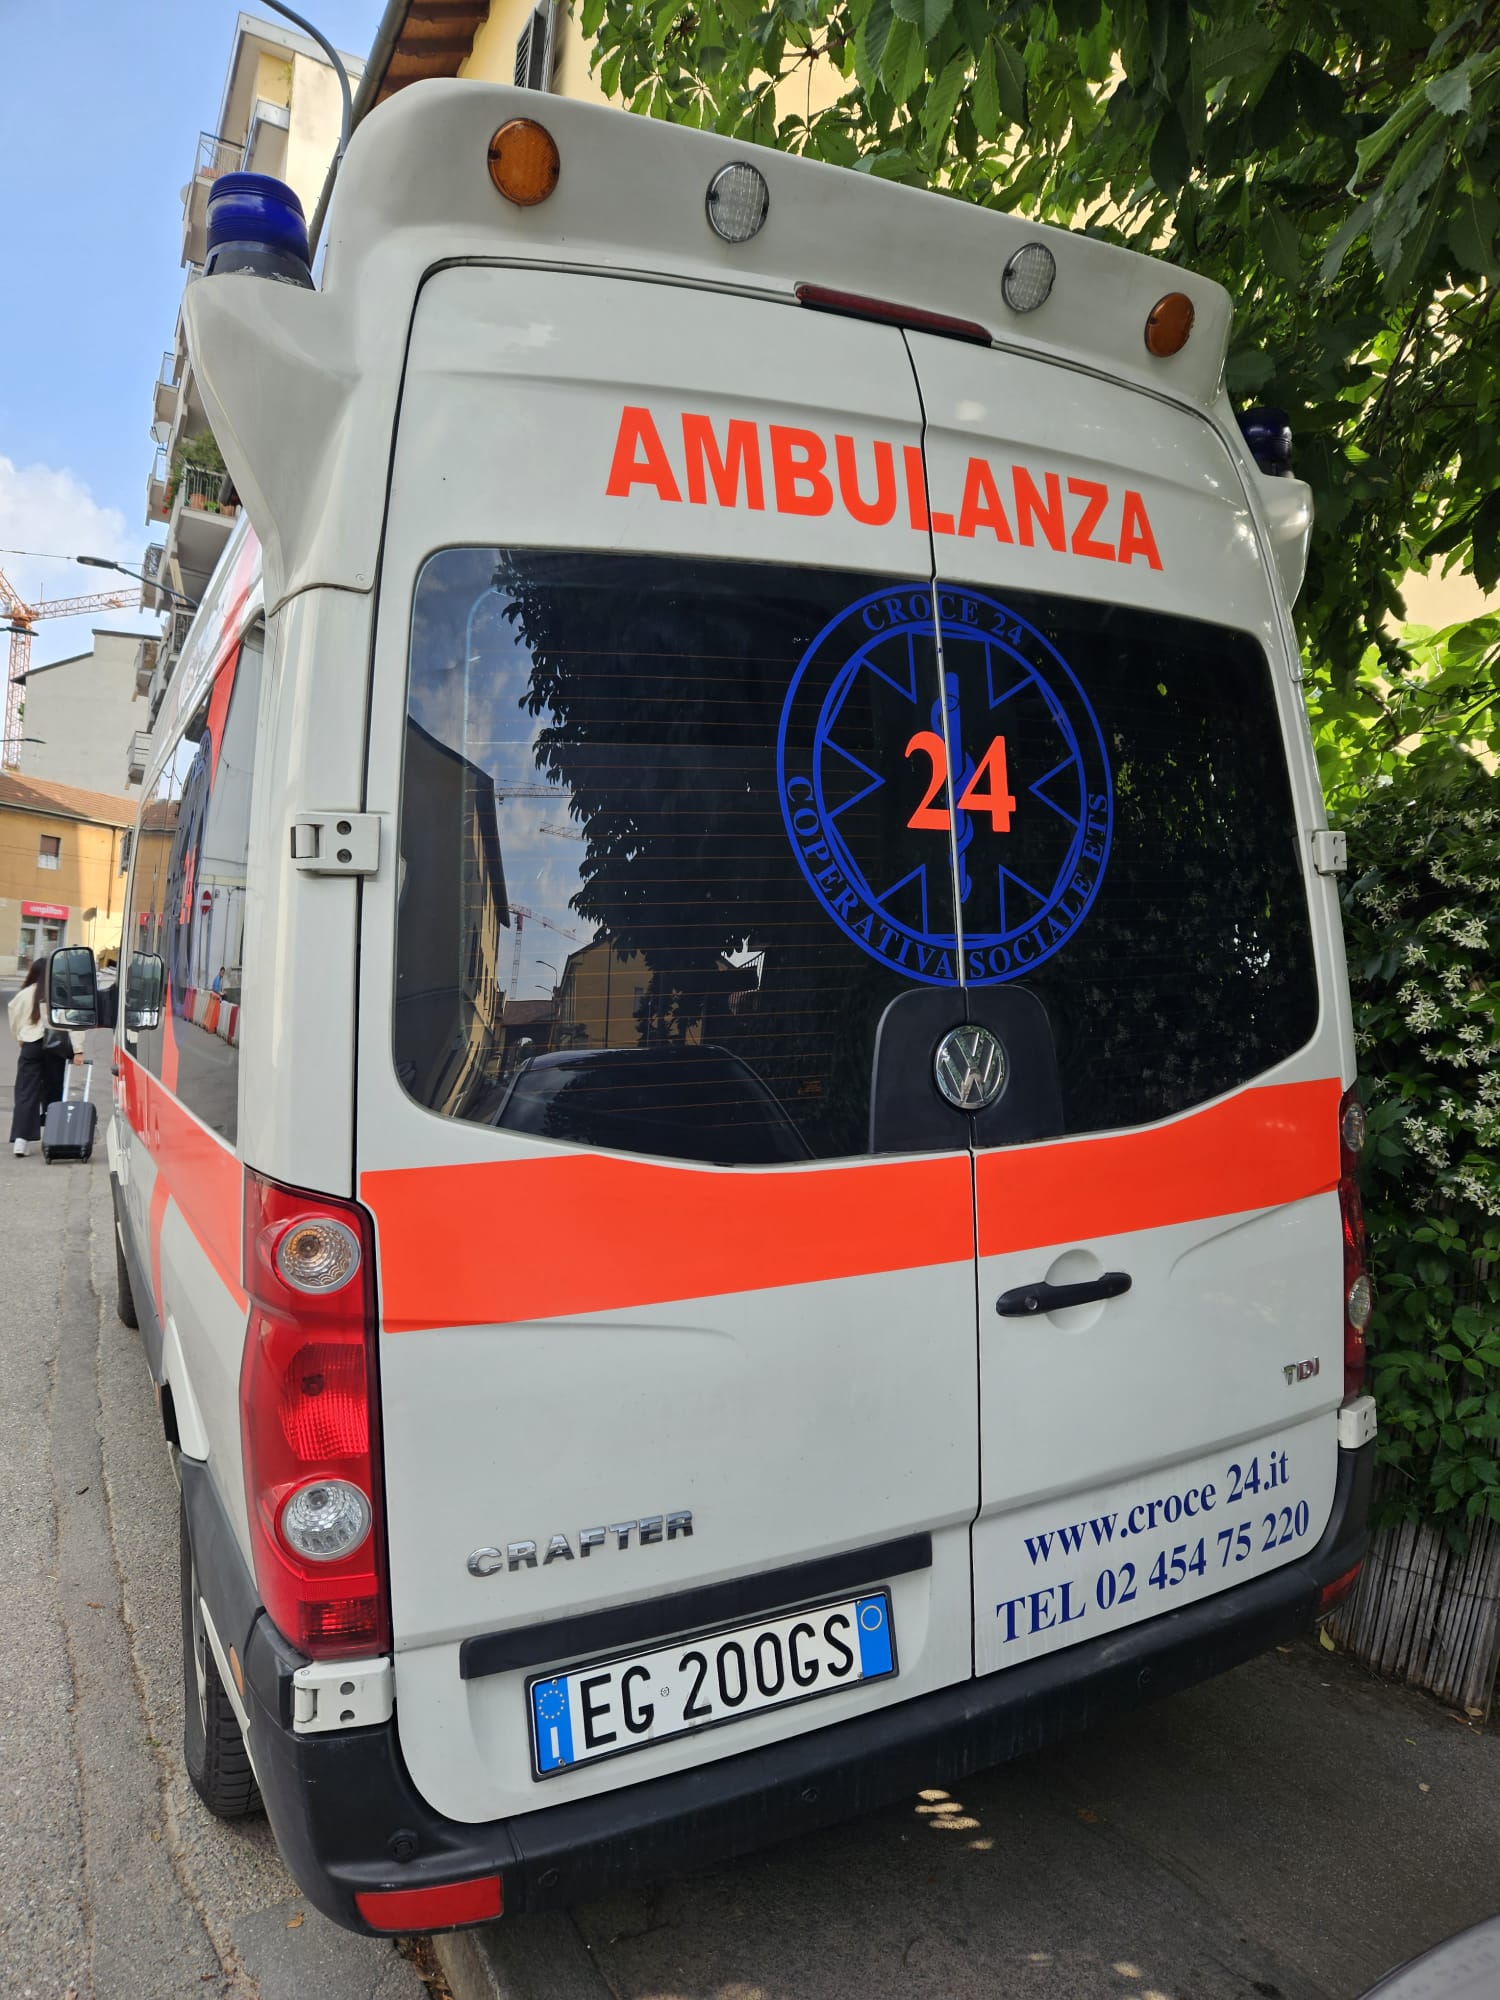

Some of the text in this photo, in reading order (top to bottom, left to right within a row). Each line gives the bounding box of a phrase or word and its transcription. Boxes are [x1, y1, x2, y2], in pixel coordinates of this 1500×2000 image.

[605, 405, 1164, 571] AMBULANZA
[862, 594, 1024, 646] CROCE 24
[904, 730, 1016, 832] 24
[787, 776, 1108, 978] COPERATIVA SOCIALE ETS
[1281, 1355, 1320, 1386] TDI
[466, 1510, 694, 1577] CRAFTER
[1023, 1450, 1290, 1566] www.croce 24.it
[996, 1500, 1309, 1643] TEL 02 454 75 220
[579, 1613, 855, 1750] EG 200GS
